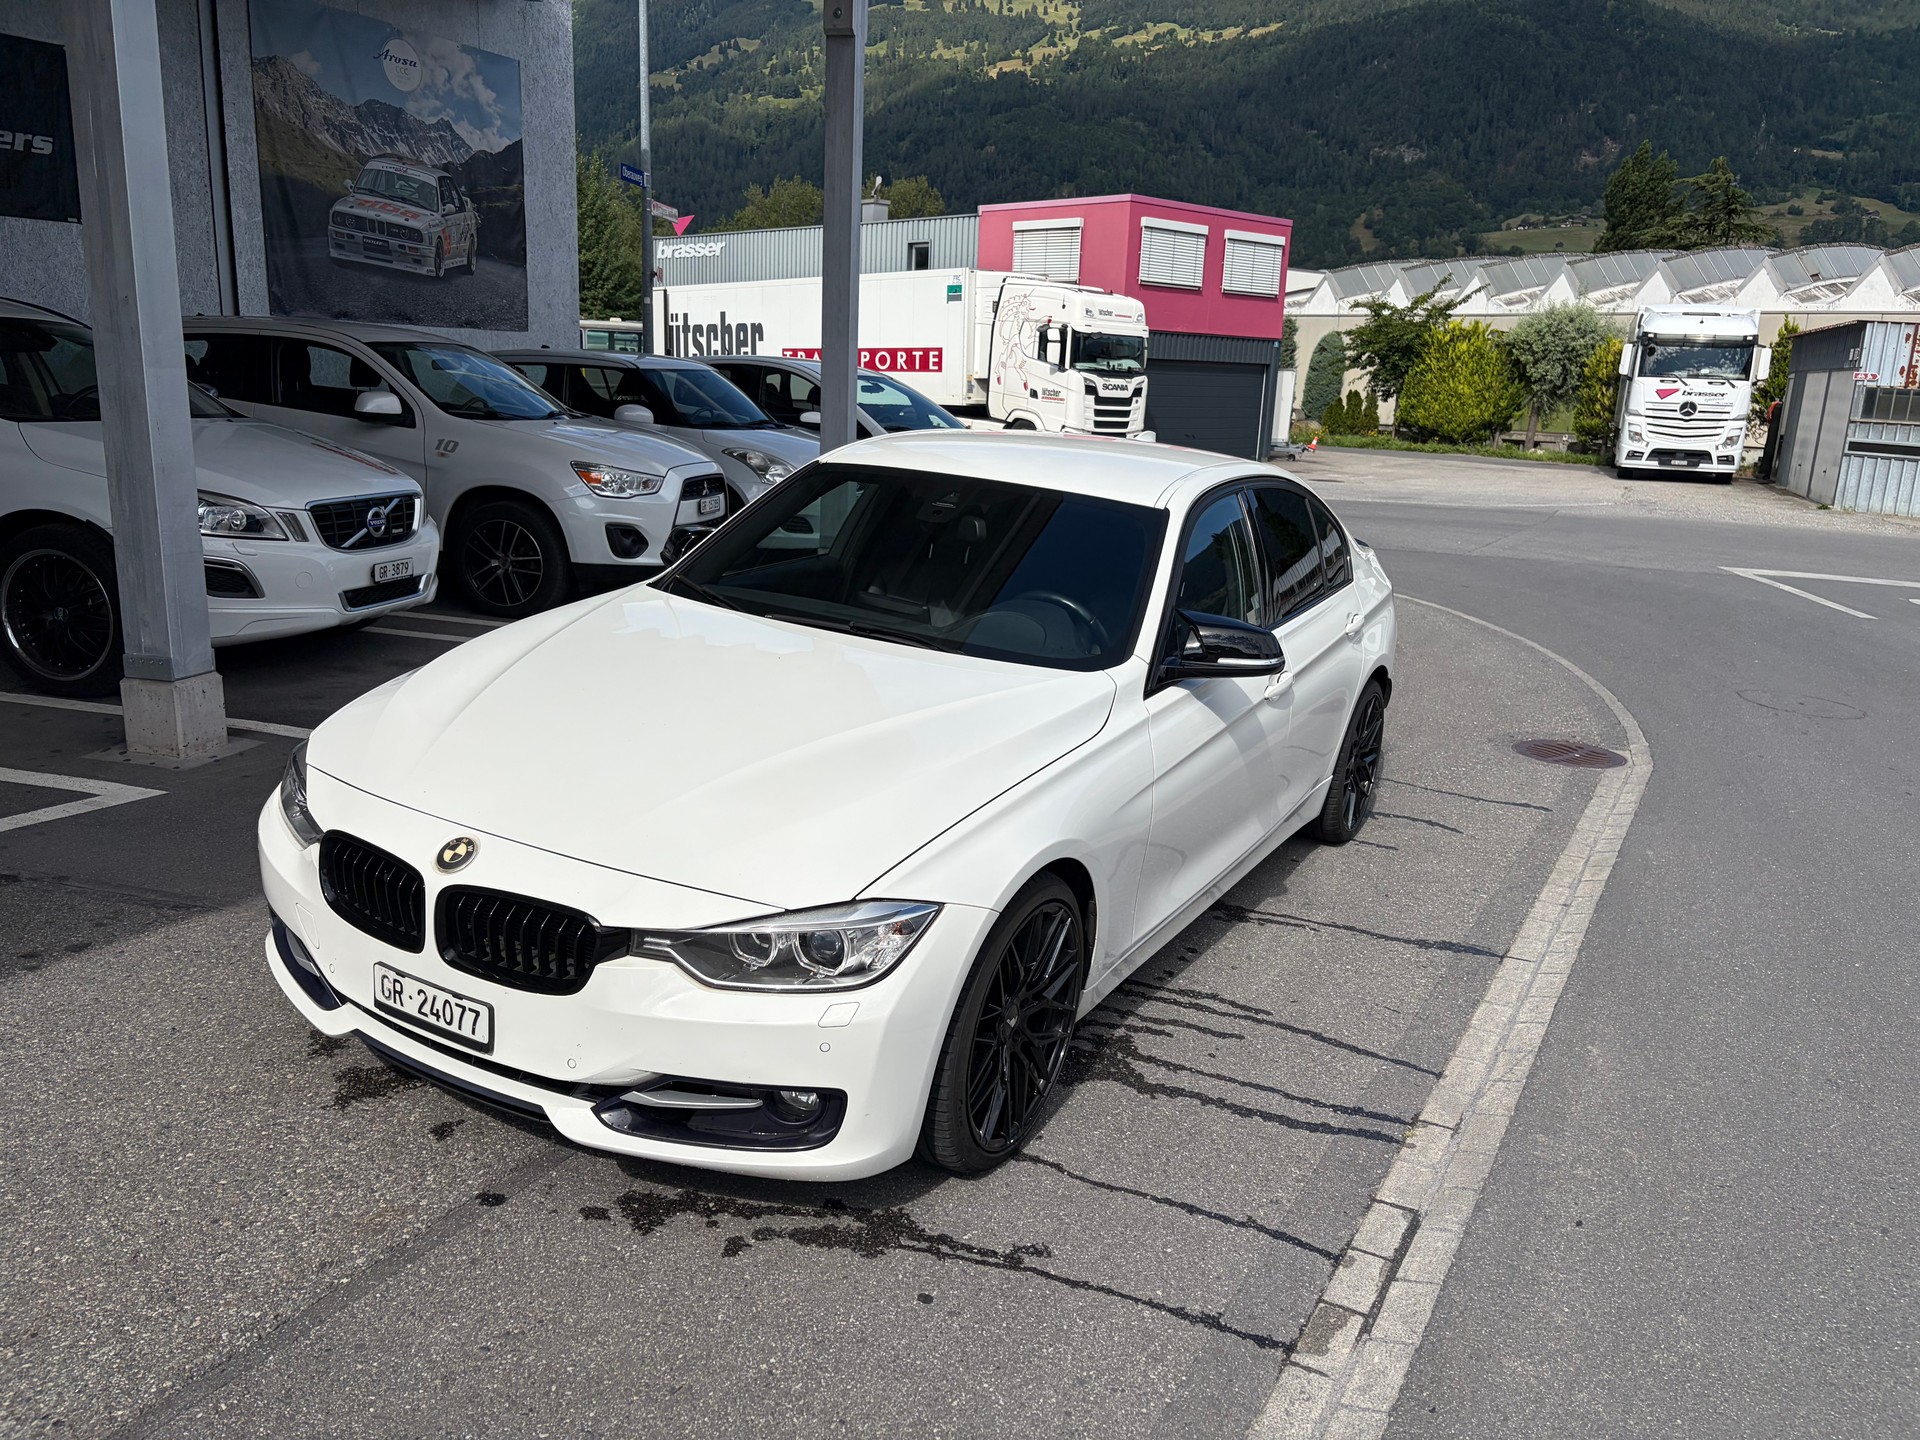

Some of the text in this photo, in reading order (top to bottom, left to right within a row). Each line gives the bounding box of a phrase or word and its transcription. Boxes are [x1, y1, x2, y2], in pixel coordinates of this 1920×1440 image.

[657, 241, 726, 259] brasser
[1102, 383, 1129, 392] SCANIA
[1682, 390, 1727, 398] brasser
[435, 438, 460, 454] 10
